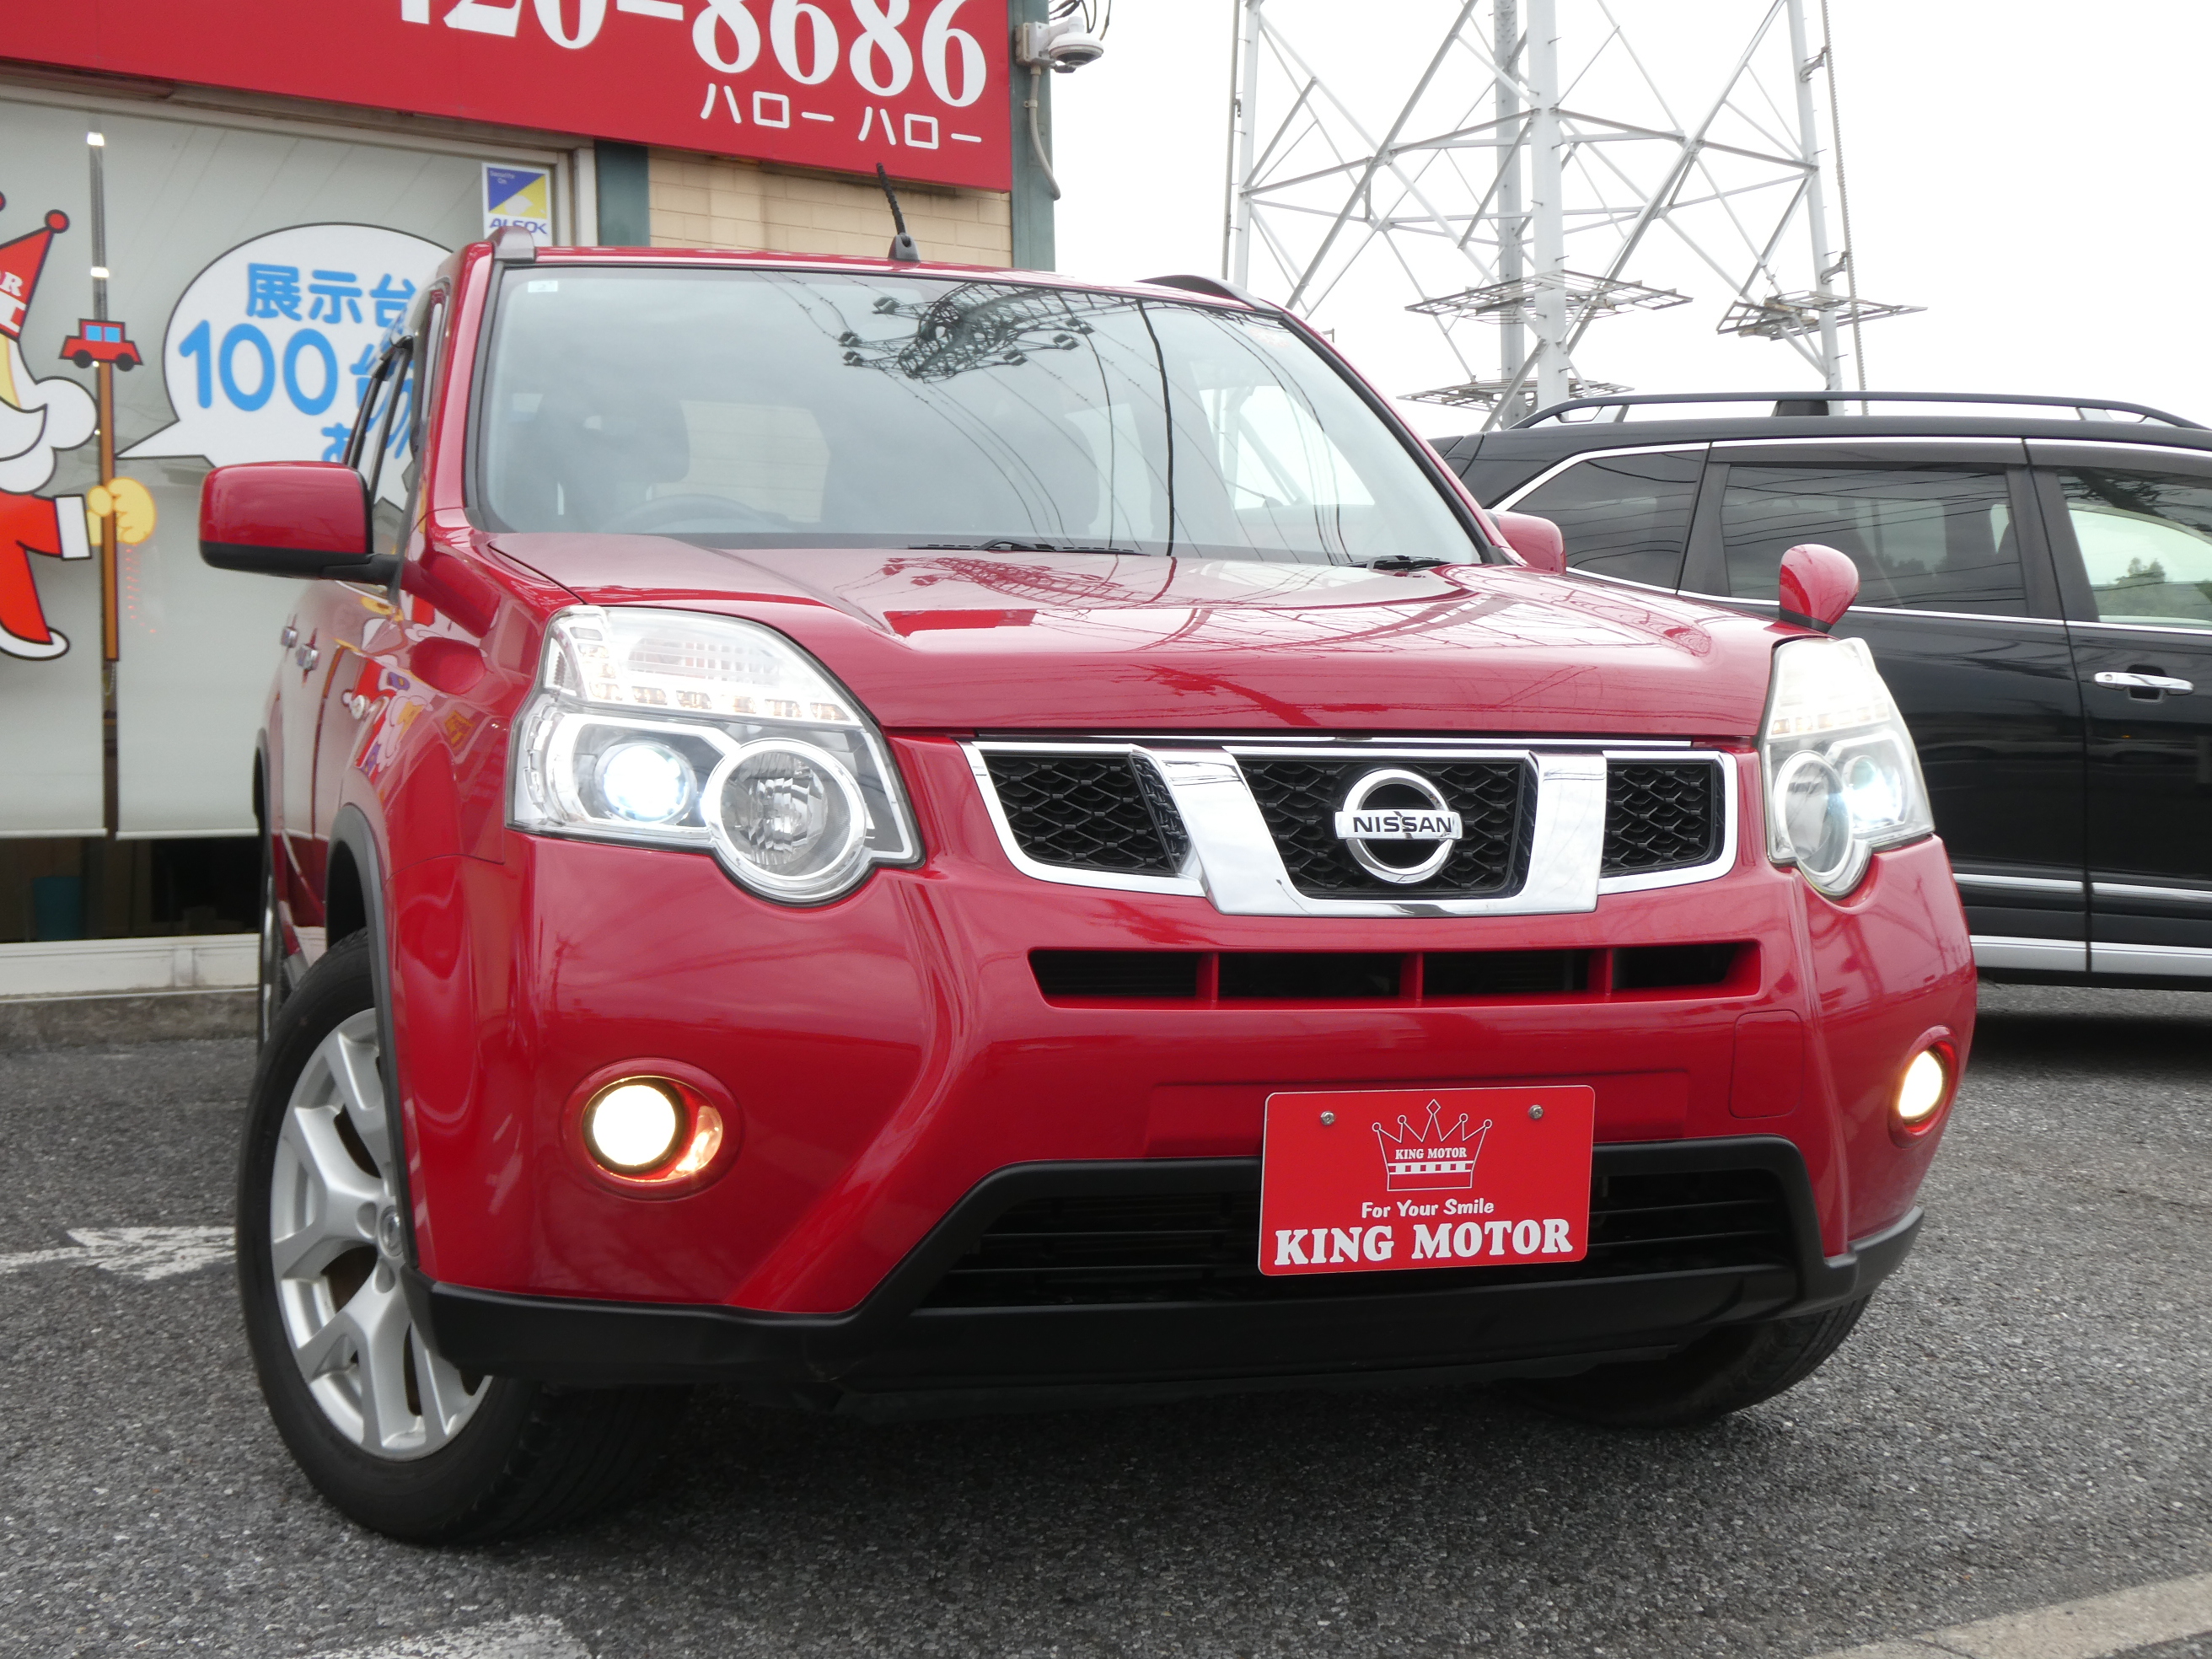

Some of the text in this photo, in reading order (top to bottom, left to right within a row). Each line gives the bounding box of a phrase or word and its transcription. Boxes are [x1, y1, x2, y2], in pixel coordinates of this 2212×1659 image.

[400, 0, 986, 107] -8686
[701, 83, 982, 149] ハロー ハロー
[0, 271, 22, 297] R
[1352, 816, 1452, 833] NISSAN
[1395, 1147, 1468, 1160] KING MOTOR
[1361, 1197, 1495, 1219] For Your Smile
[1274, 1218, 1573, 1266] KING MOTOR
